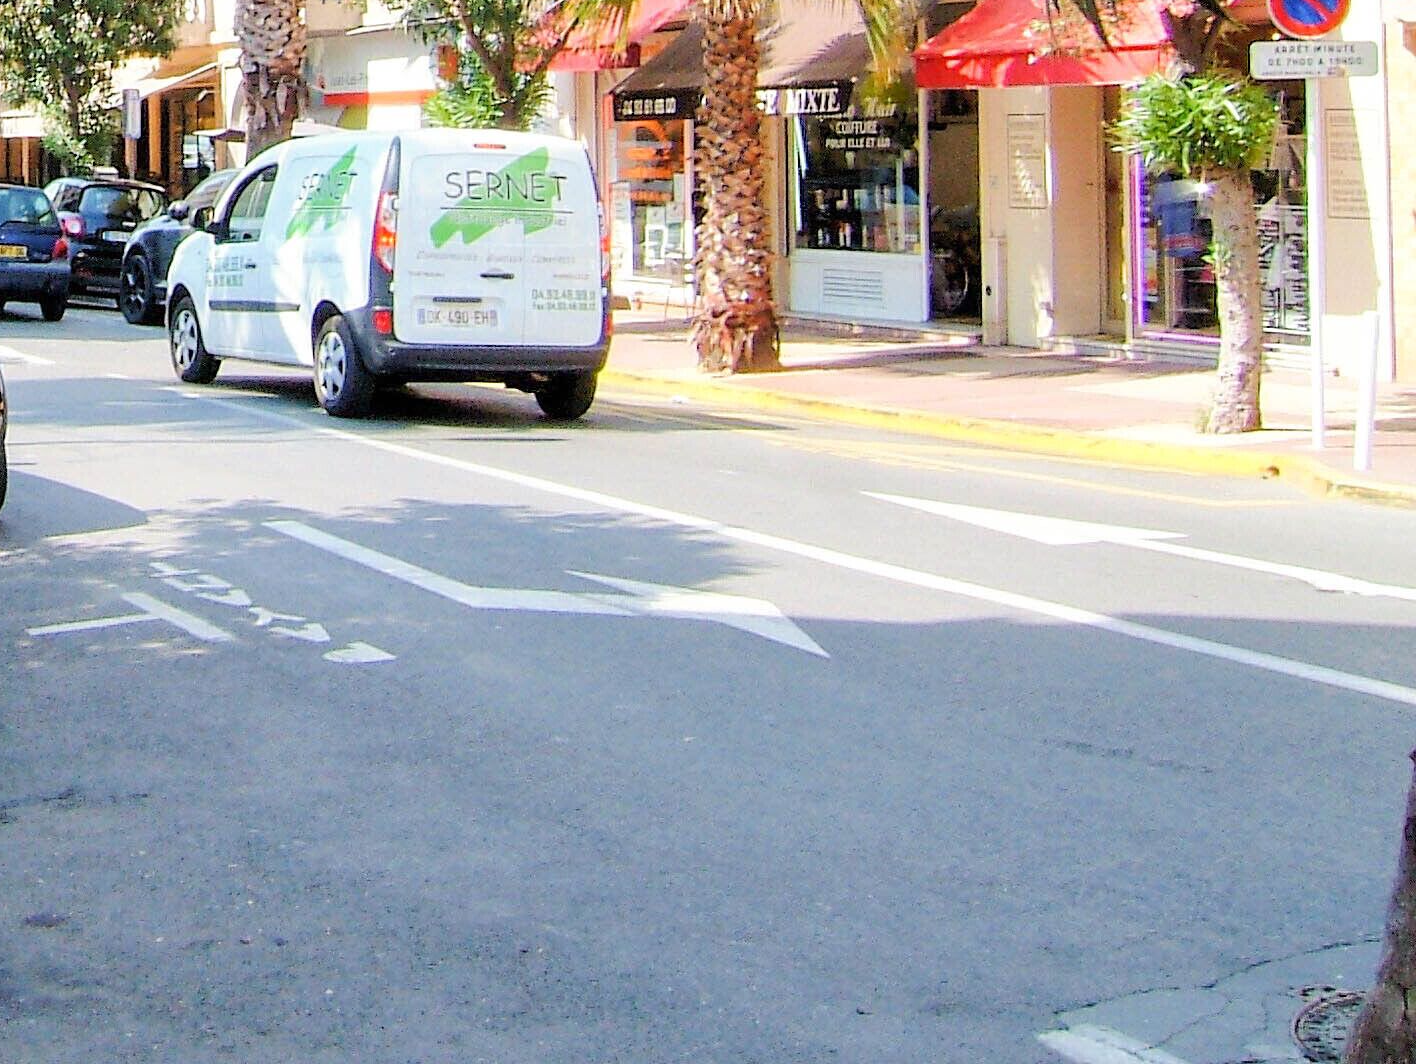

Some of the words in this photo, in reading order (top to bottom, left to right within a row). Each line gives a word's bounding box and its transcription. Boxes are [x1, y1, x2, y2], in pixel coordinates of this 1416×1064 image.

[1313, 45, 1355, 54] MINUTE
[786, 87, 840, 114] MIXTE
[297, 170, 358, 201] SERNET
[443, 169, 567, 202] SERNET
